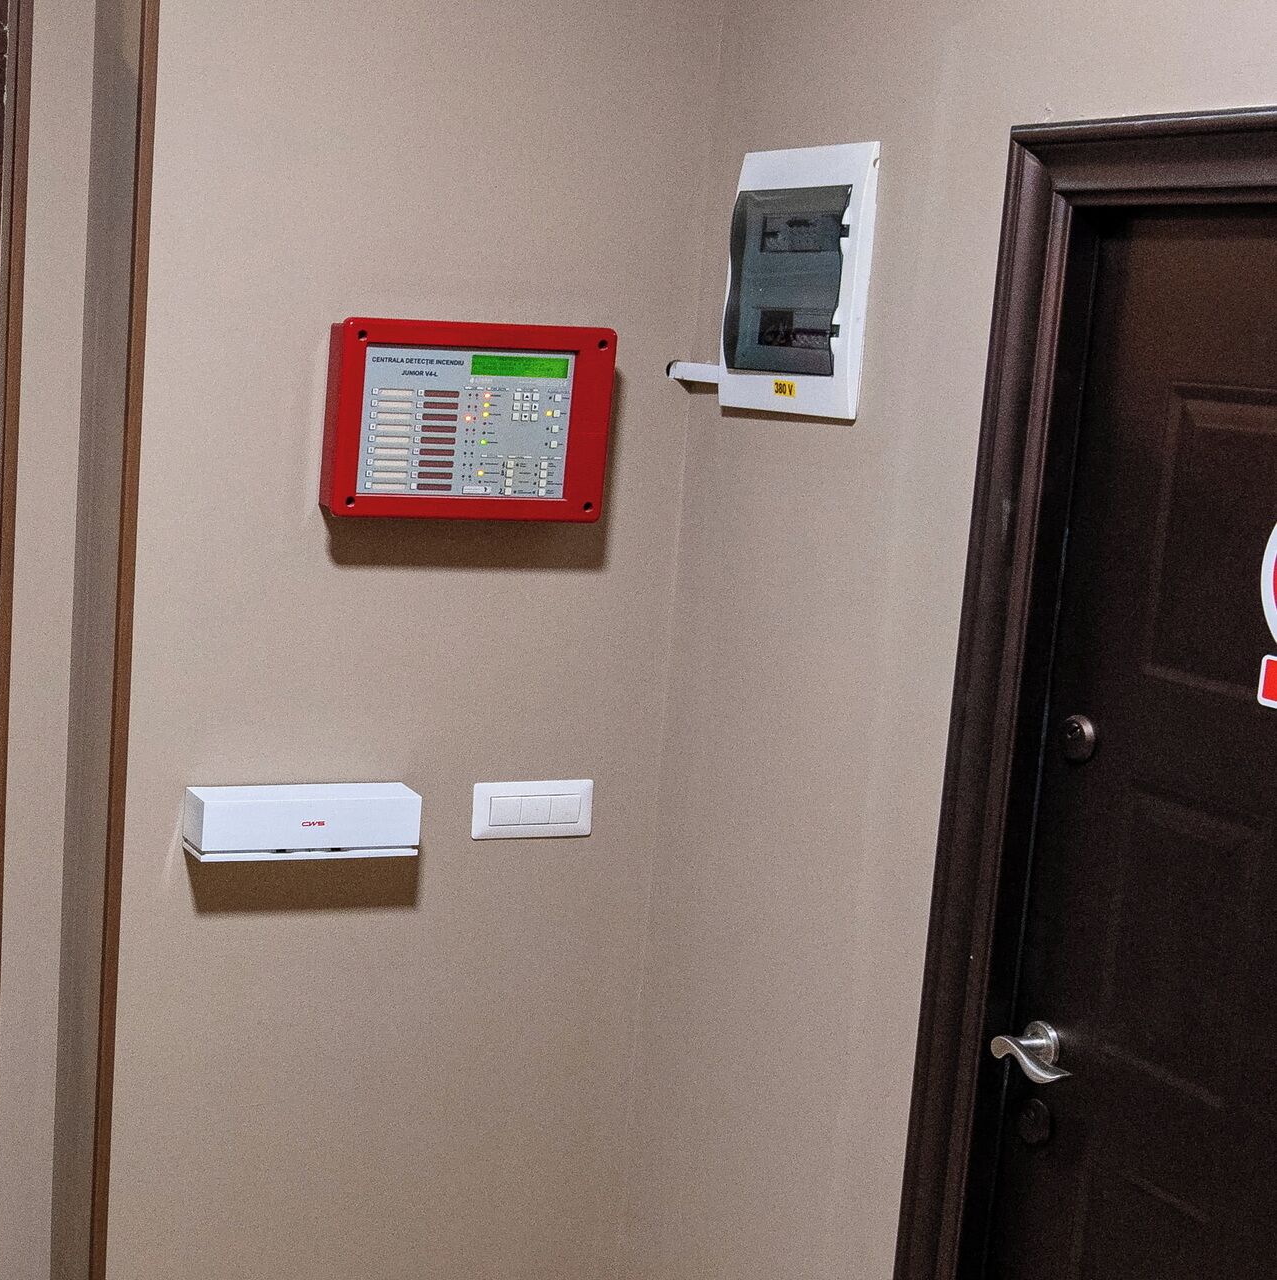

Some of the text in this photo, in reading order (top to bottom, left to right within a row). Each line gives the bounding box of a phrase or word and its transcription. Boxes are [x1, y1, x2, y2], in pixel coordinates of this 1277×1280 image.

[371, 356, 404, 364] CENTRALA
[774, 382, 793, 396] 380 V
